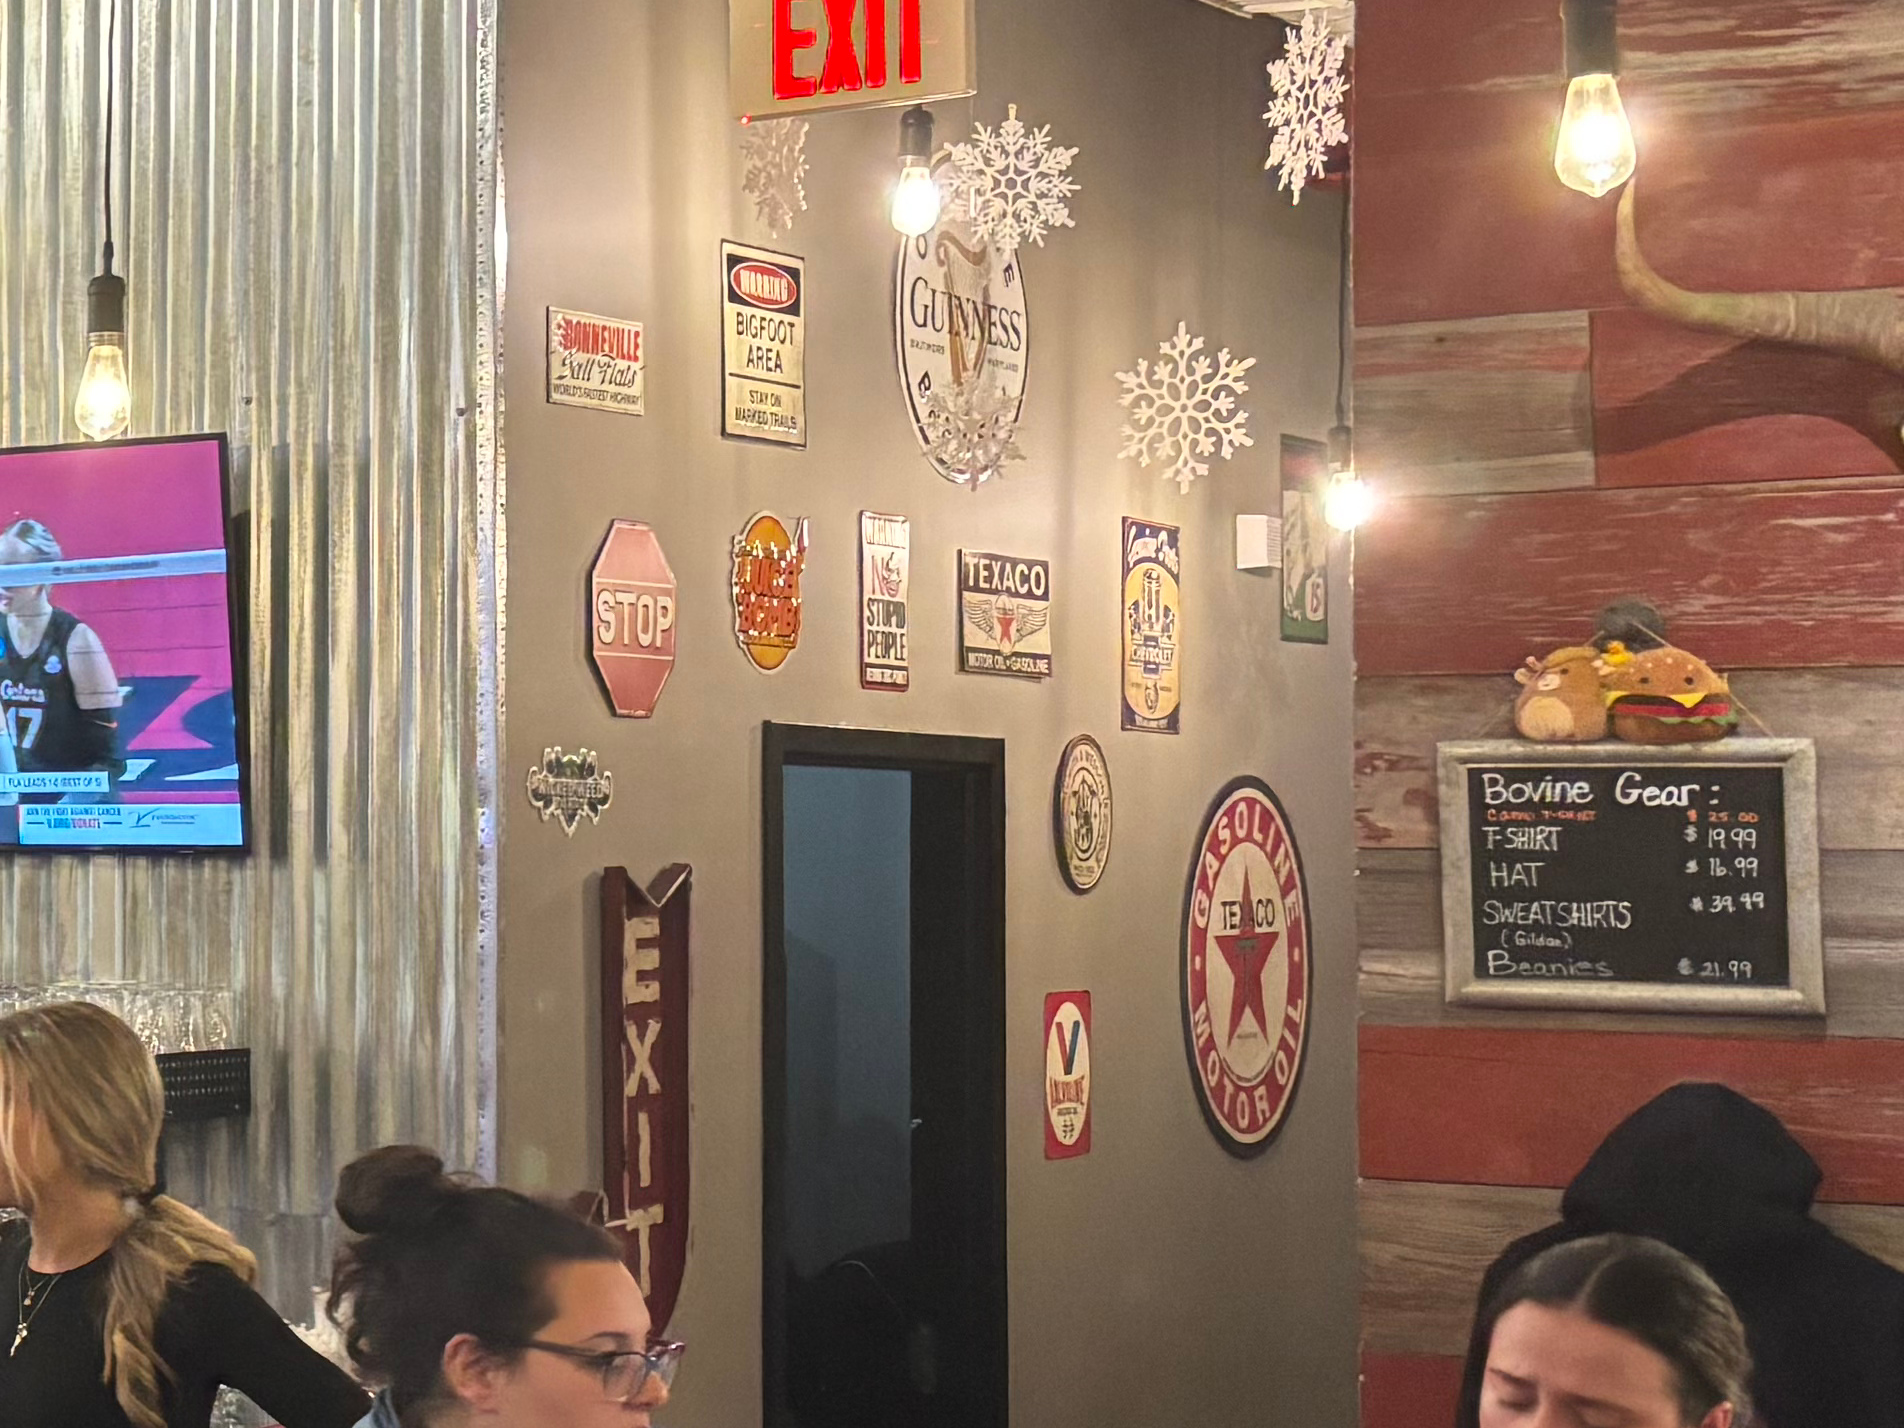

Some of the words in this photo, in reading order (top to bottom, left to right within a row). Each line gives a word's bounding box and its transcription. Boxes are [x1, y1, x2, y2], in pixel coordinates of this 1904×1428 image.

[739, 269, 789, 303] WARNING
[736, 311, 796, 347] BIGFOOT
[910, 276, 1021, 352] GUINNESS
[746, 344, 784, 374] AREA
[748, 389, 768, 406] STAY
[770, 393, 782, 408] ON
[735, 406, 768, 426] MARKED
[769, 411, 797, 430] TRAILS
[964, 556, 1046, 597] TEXACO
[595, 585, 674, 649] STOP
[866, 597, 906, 629] STUPID
[866, 629, 907, 662] PEOPLE
[1481, 773, 1594, 804] Bovine
[1481, 826, 1563, 851] T-SHIRT
[1683, 824, 1698, 842] $
[1193, 800, 1301, 929] GASOLINE
[1490, 861, 1545, 887] HAT
[1487, 950, 1614, 977] Beanies
[1273, 997, 1302, 1086] OIL
[1193, 998, 1271, 1131] MOTOR
[624, 915, 665, 1299] EXIT
